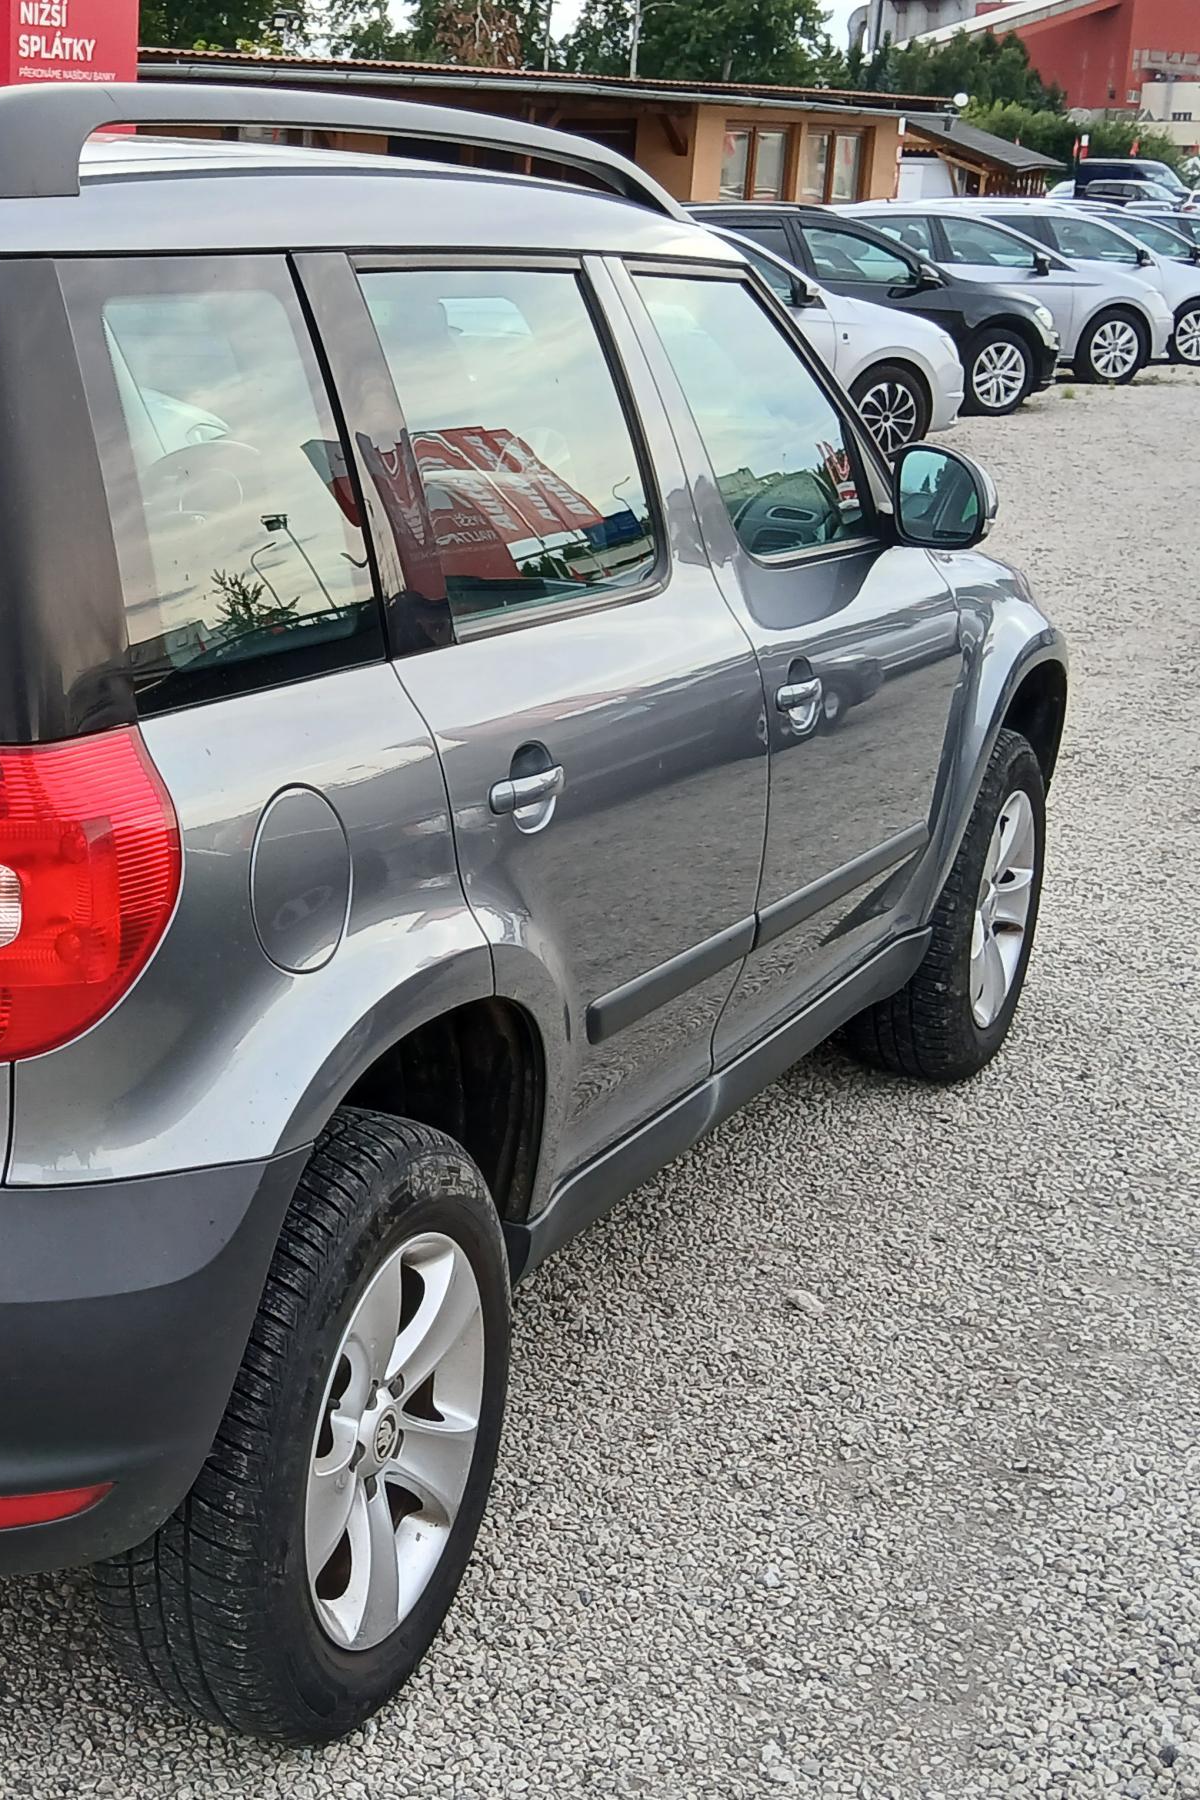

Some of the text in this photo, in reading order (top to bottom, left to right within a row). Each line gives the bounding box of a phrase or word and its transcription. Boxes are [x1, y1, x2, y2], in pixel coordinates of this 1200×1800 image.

[19, 0, 67, 27] NIŽŠÍ
[18, 31, 96, 61] SPLÁTKY
[93, 71, 116, 81] BANKY
